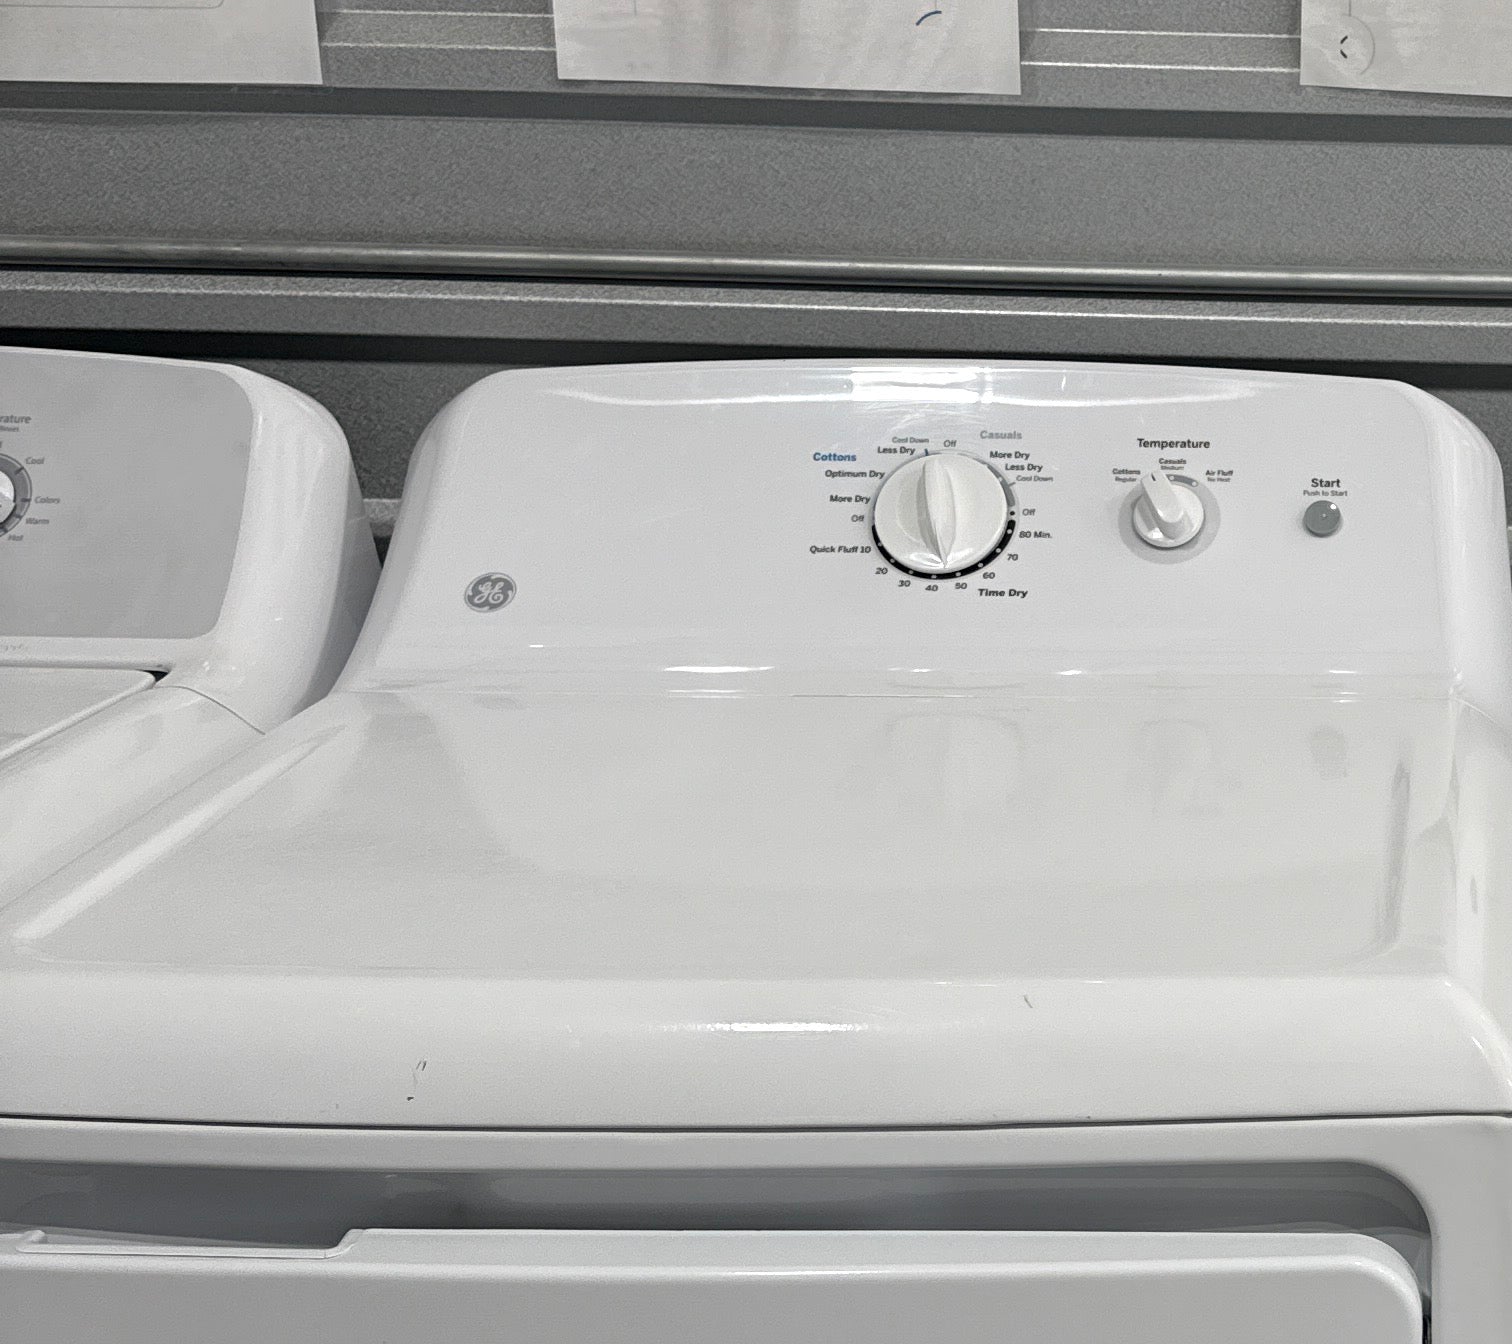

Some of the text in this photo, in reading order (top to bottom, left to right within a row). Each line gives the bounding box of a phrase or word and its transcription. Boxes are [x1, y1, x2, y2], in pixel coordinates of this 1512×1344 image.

[979, 429, 1023, 440] Casuals
[943, 439, 957, 448] Off
[1136, 437, 1211, 451] Temperature
[877, 445, 916, 456] Less Dry
[812, 451, 857, 462] Cottons
[824, 469, 886, 480] Optimum Dry
[1310, 477, 1341, 488] Start
[829, 494, 872, 505] More Dry
[809, 545, 836, 555] Quick
[977, 588, 1029, 599] Time Dry
